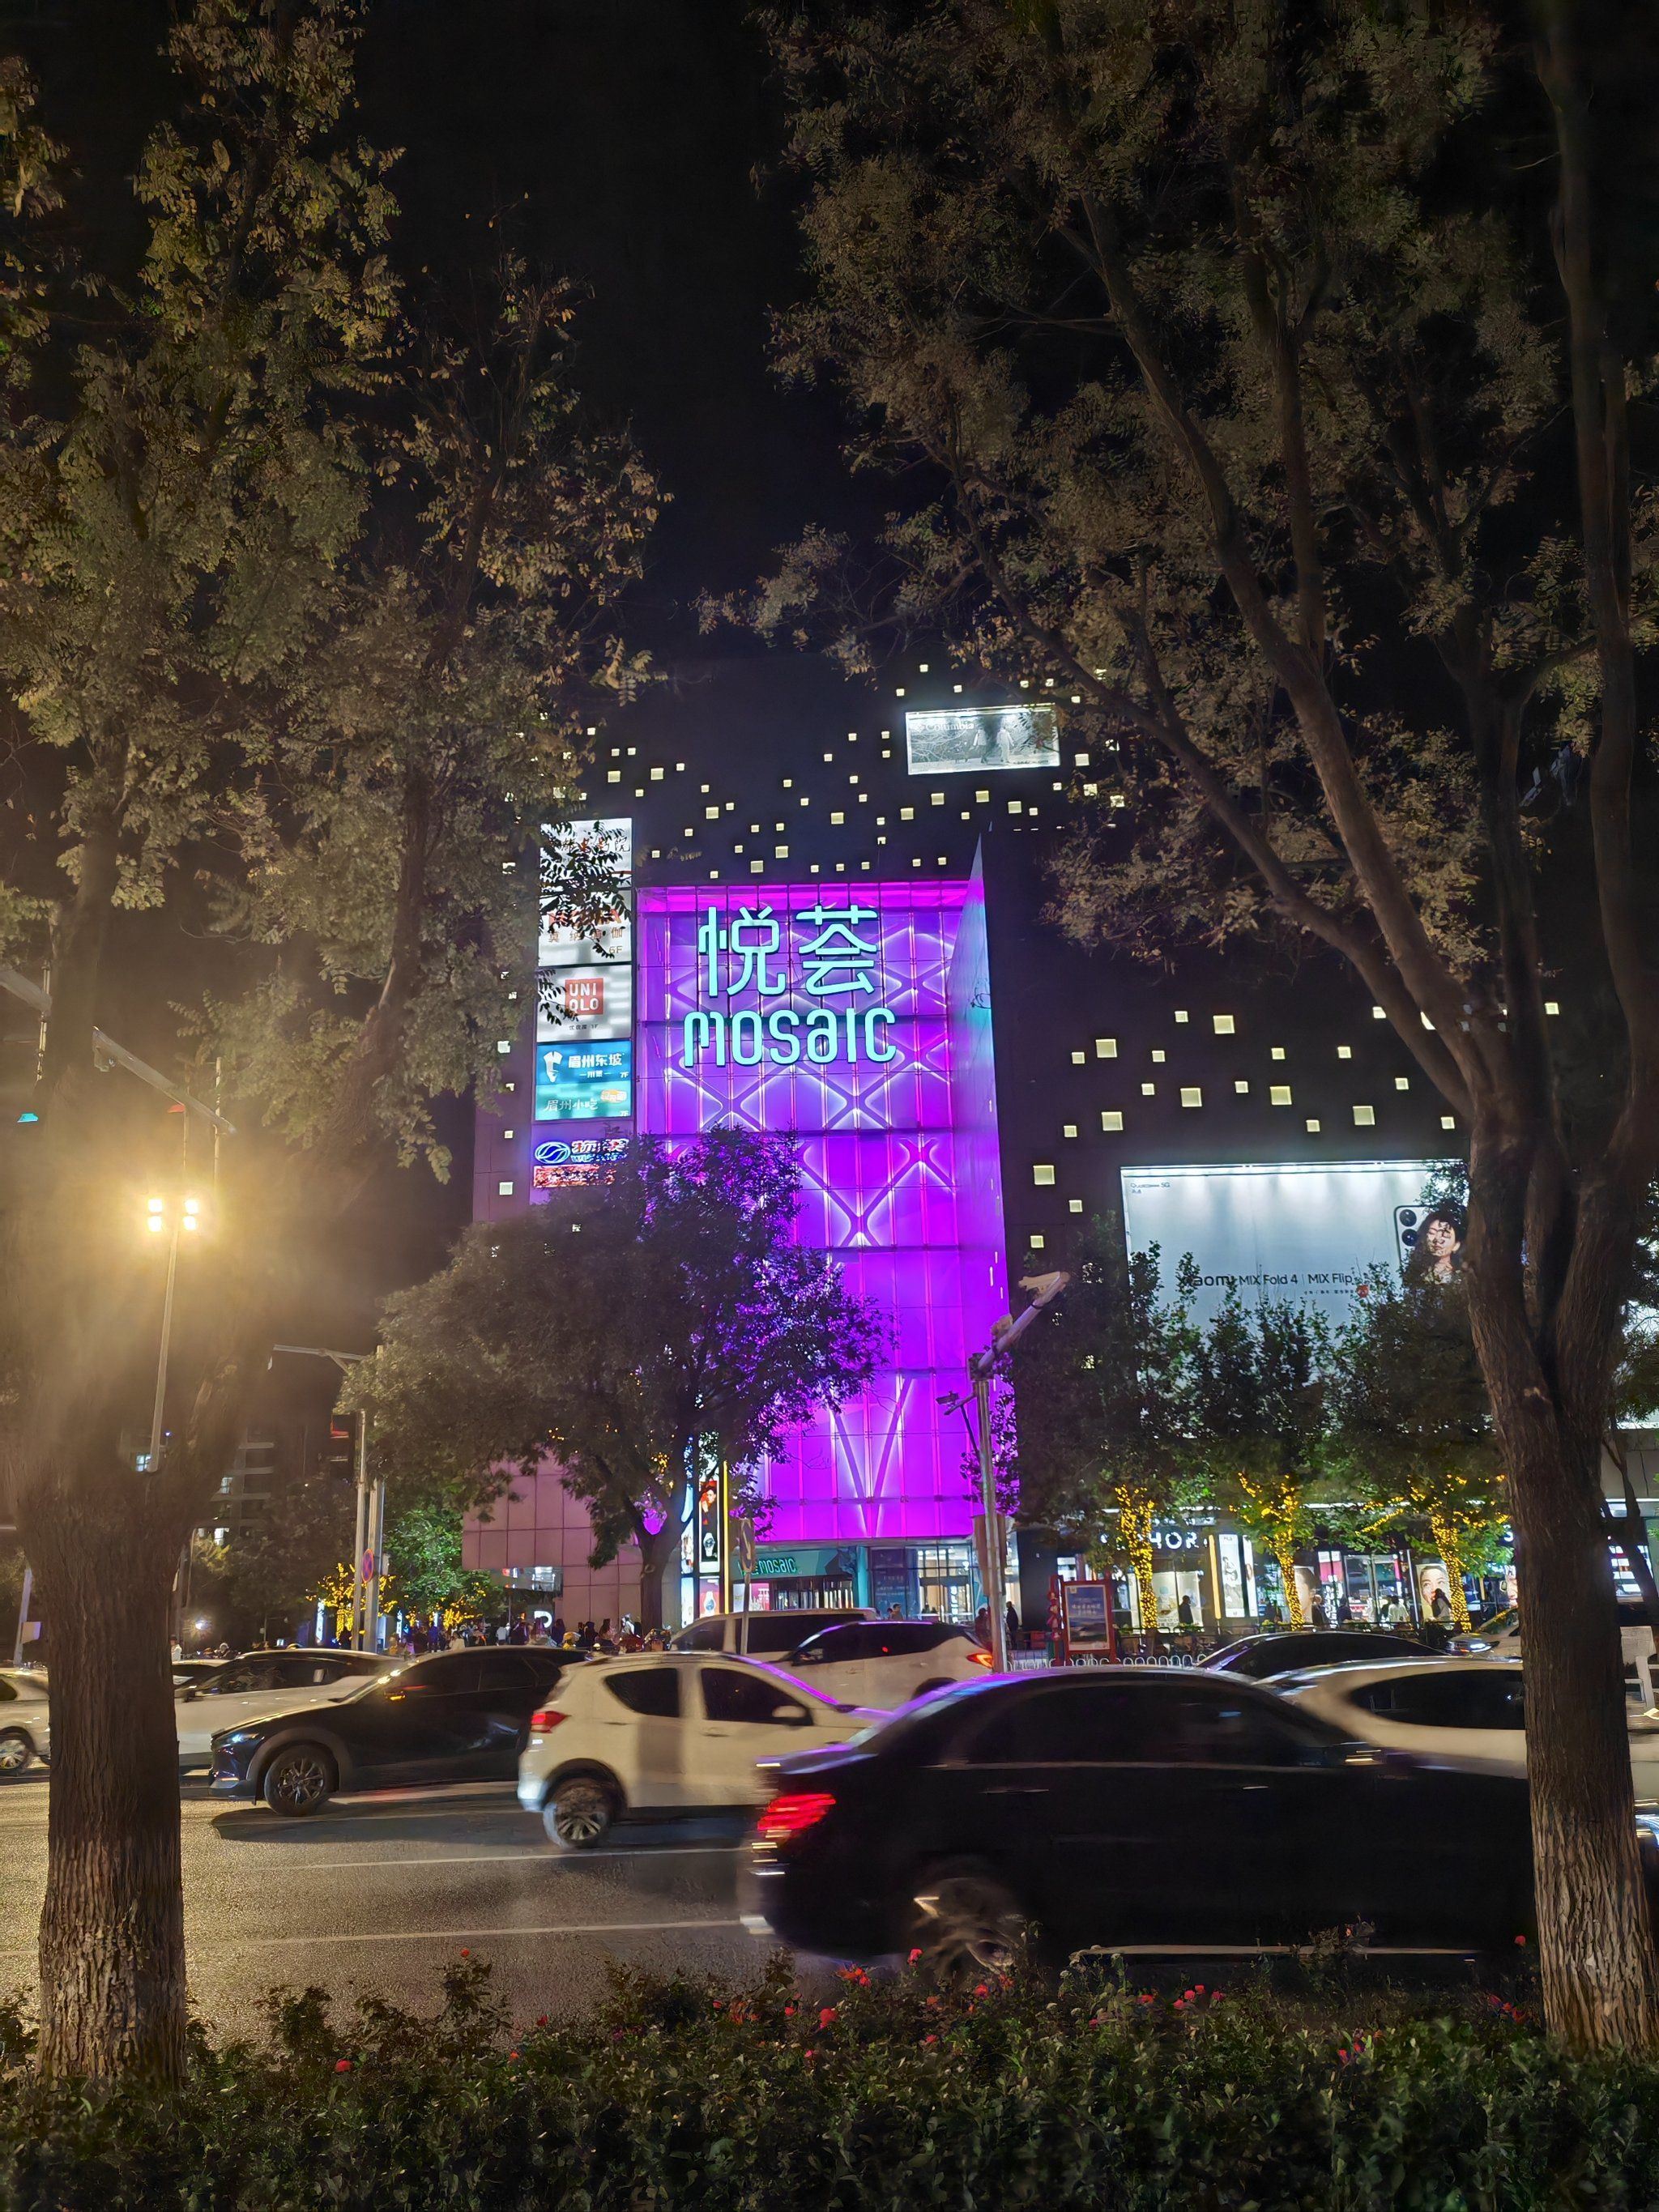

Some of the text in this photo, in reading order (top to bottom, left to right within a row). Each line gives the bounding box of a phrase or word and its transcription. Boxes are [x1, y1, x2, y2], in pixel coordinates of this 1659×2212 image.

[926, 722, 975, 731] Columbia
[609, 945, 623, 954] 6F
[698, 905, 878, 997] 悦荟
[569, 982, 597, 996] UNI
[569, 998, 599, 1013] QLO
[569, 1053, 622, 1068] 眉州东坡
[544, 1098, 598, 1112] 眉州小吃
[1239, 1275, 1260, 1285] MIX
[1264, 1274, 1287, 1285] Fold
[1290, 1274, 1298, 1285] 4
[1308, 1273, 1329, 1285] MIX
[1333, 1272, 1353, 1285] Flip
